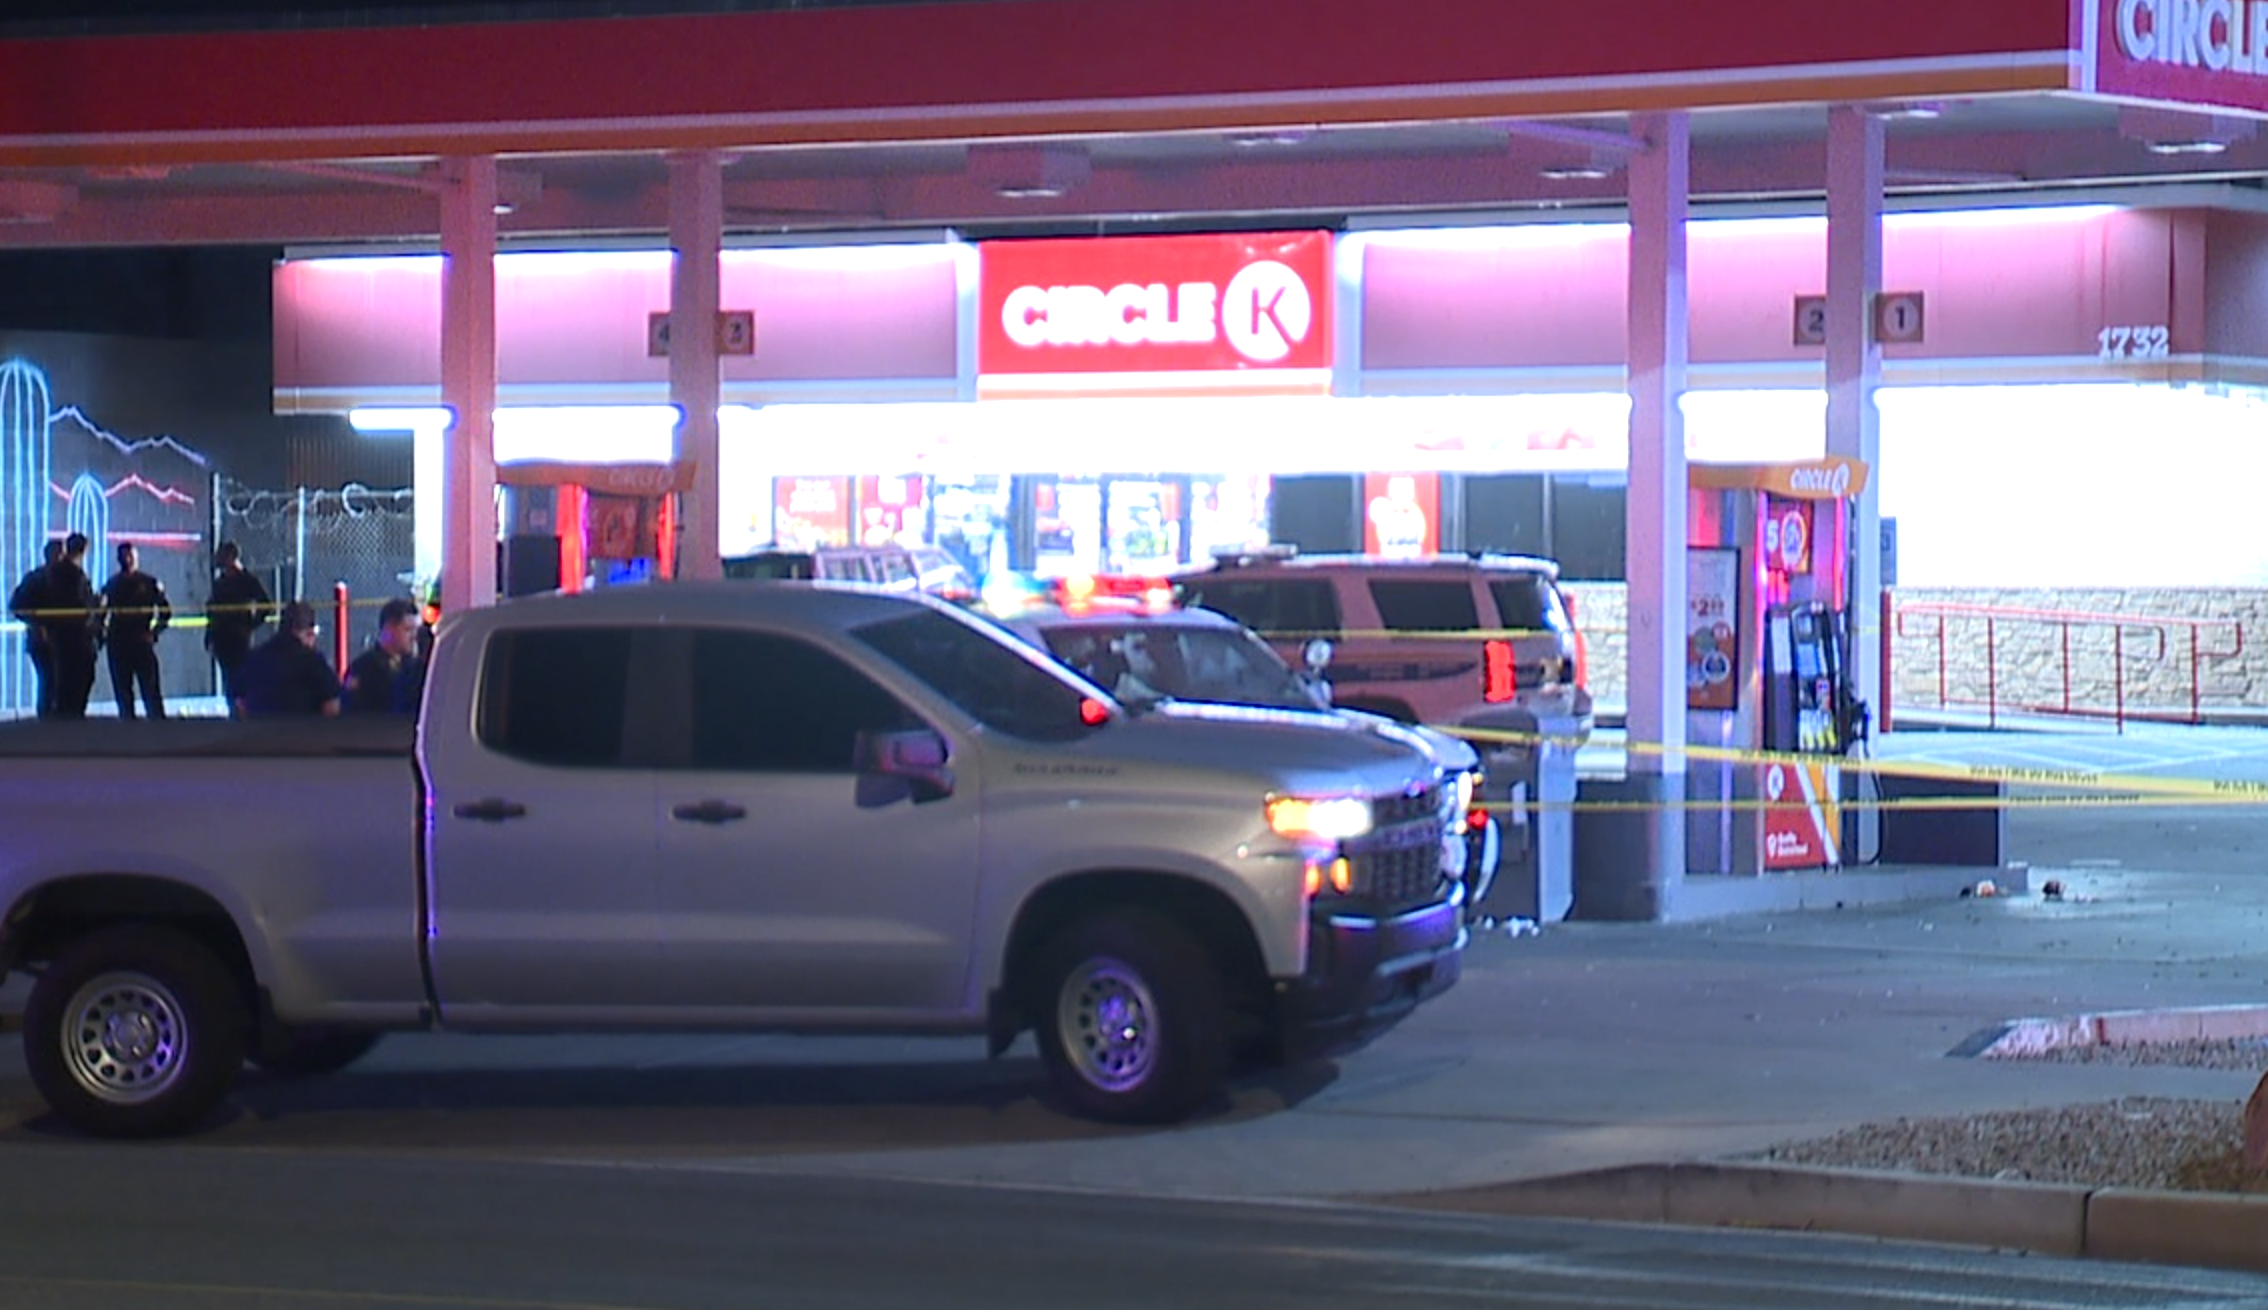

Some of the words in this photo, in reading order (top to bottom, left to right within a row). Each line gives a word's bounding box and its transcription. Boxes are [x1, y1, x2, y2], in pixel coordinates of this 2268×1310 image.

[2118, 0, 2268, 75] CIRCLE
[1002, 282, 1216, 346] CIRCLE
[1222, 260, 1311, 361] K
[1808, 308, 1824, 332] 2
[1894, 305, 1905, 329] 1
[2098, 326, 2169, 358] 1732
[1790, 468, 1833, 491] CIRCLE
